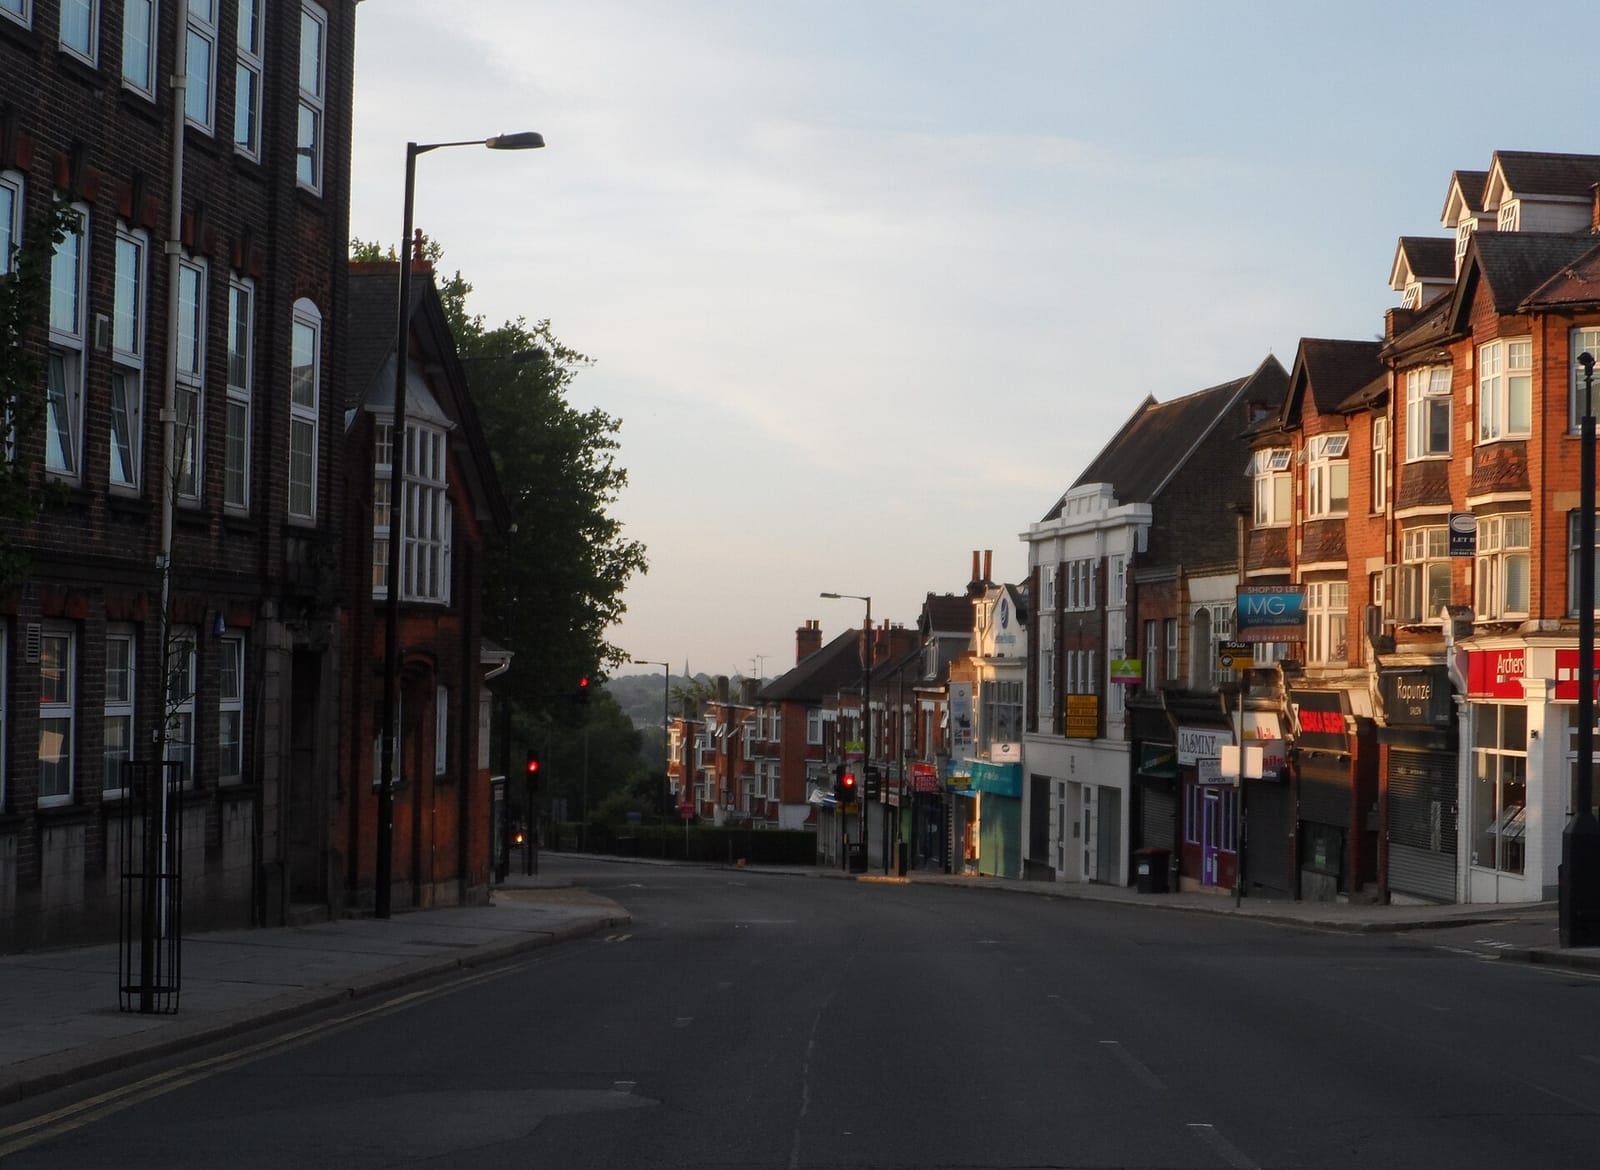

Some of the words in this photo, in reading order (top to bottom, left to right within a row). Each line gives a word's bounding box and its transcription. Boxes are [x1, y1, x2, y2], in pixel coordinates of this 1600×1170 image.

[1248, 596, 1285, 615] MG
[1497, 652, 1524, 673] Archers
[1180, 733, 1216, 756] JASMINE
